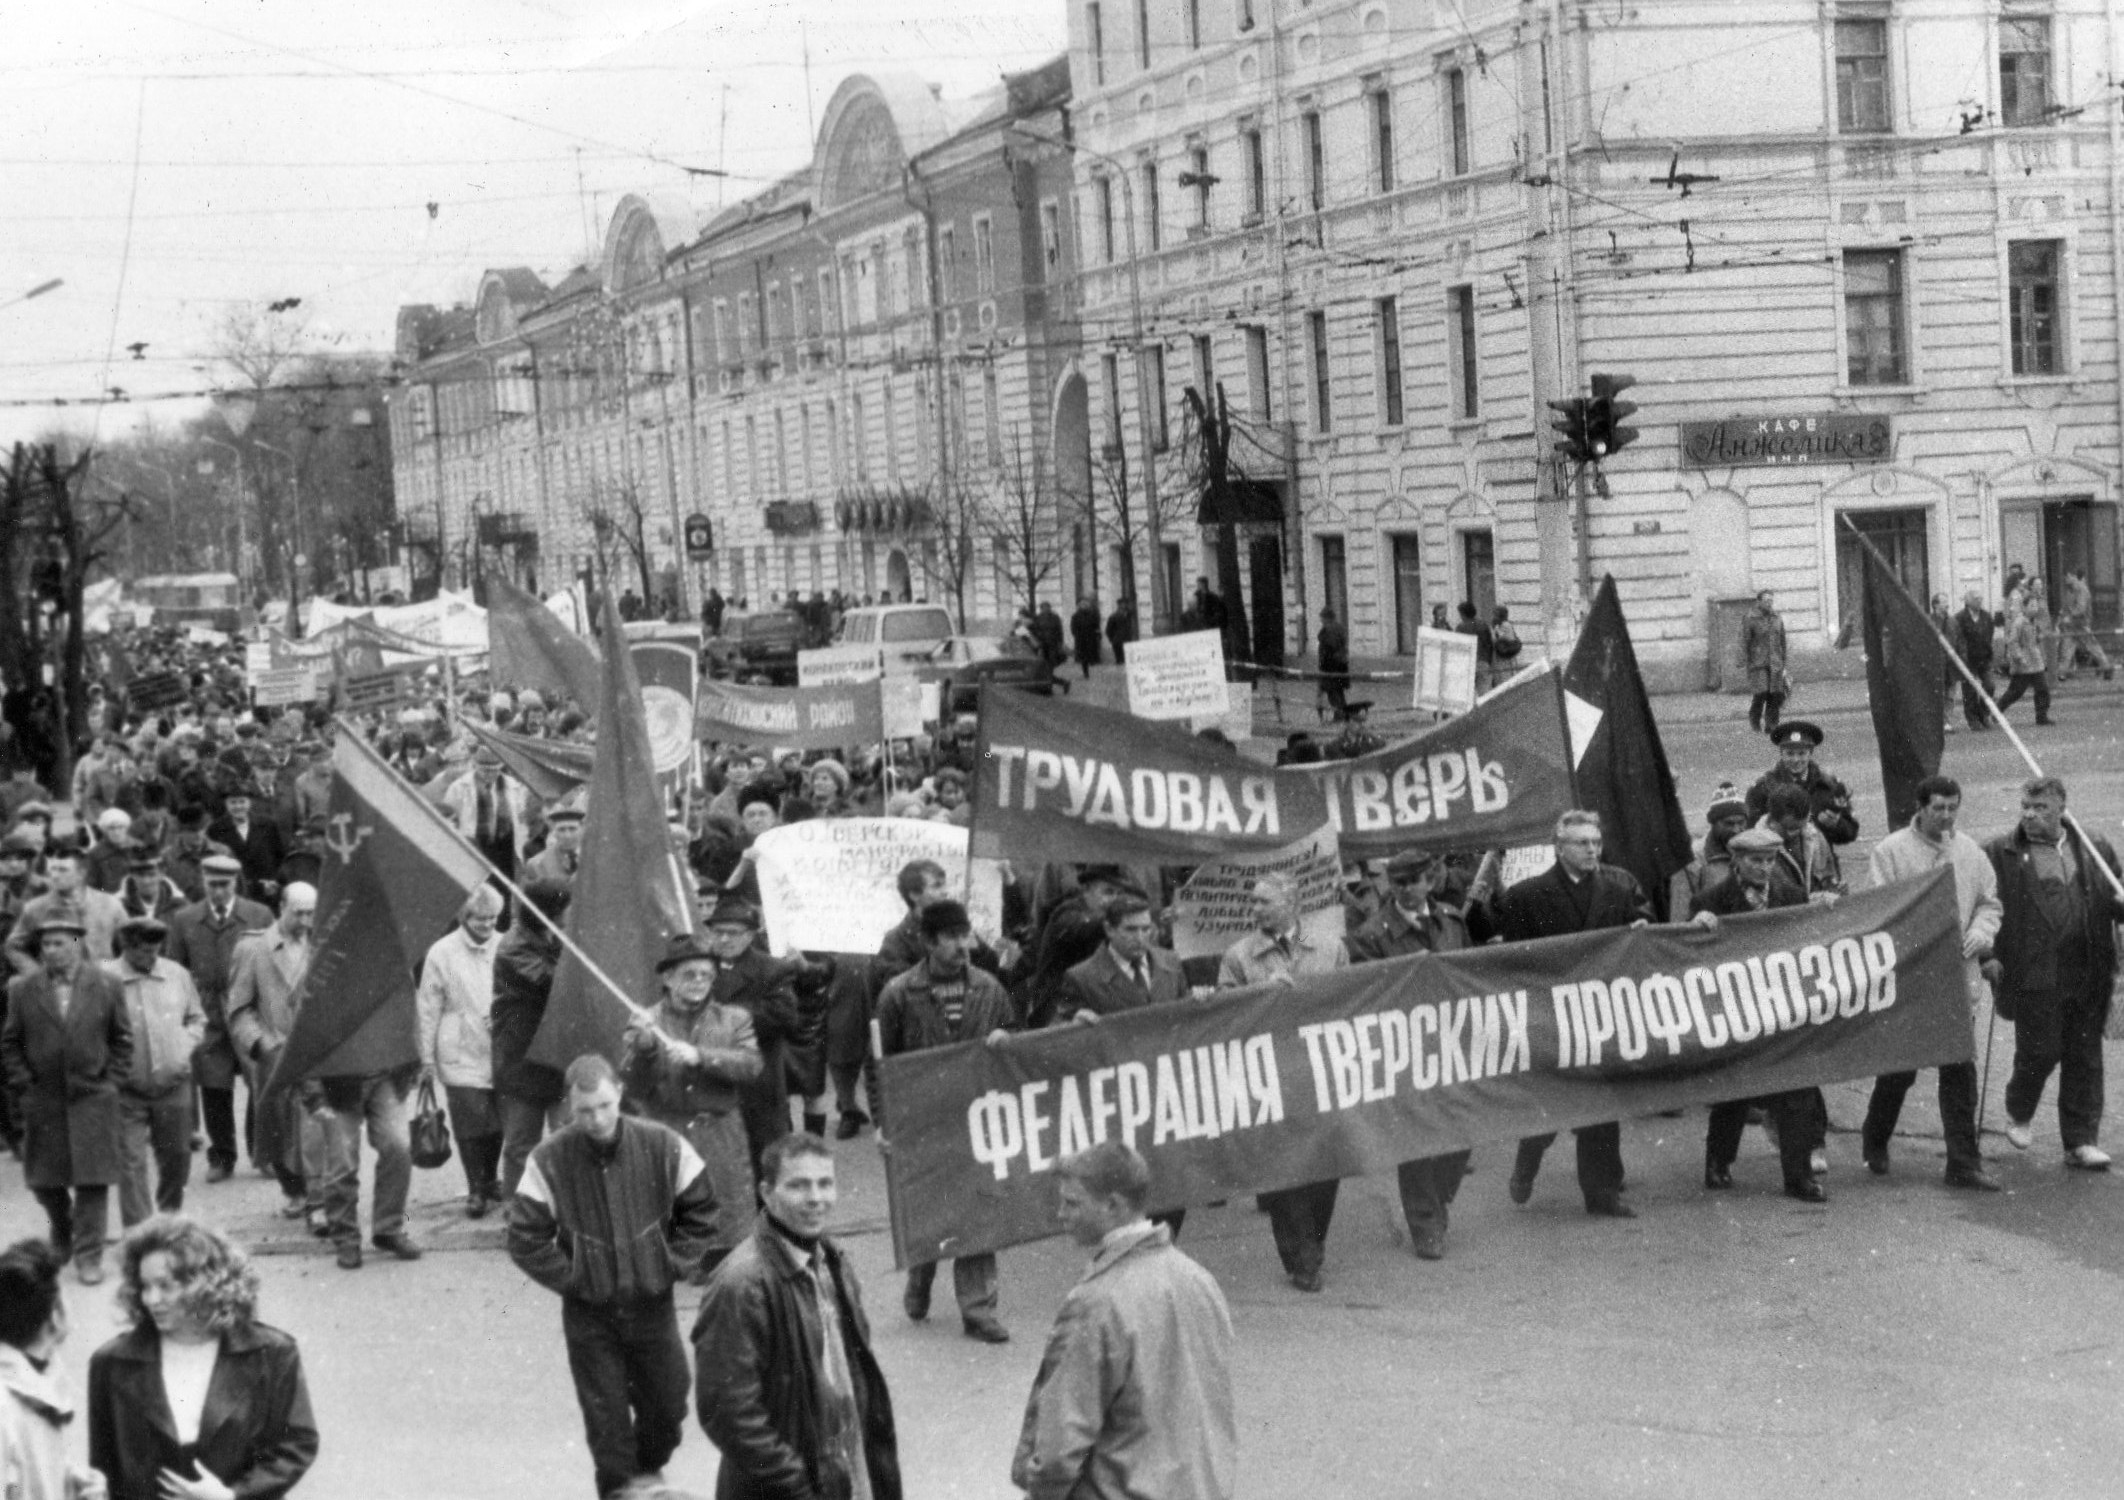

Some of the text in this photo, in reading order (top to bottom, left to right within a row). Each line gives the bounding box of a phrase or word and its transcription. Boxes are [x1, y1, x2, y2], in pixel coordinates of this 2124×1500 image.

[1759, 418, 1816, 433] КАФЕ
[990, 742, 1509, 835] ТРУДОВАЯ ТВЕРЬ
[1299, 990, 1530, 1112] ТВЕРСКИХ
[1552, 931, 1897, 1068] ПРОФСОЮЗОВ
